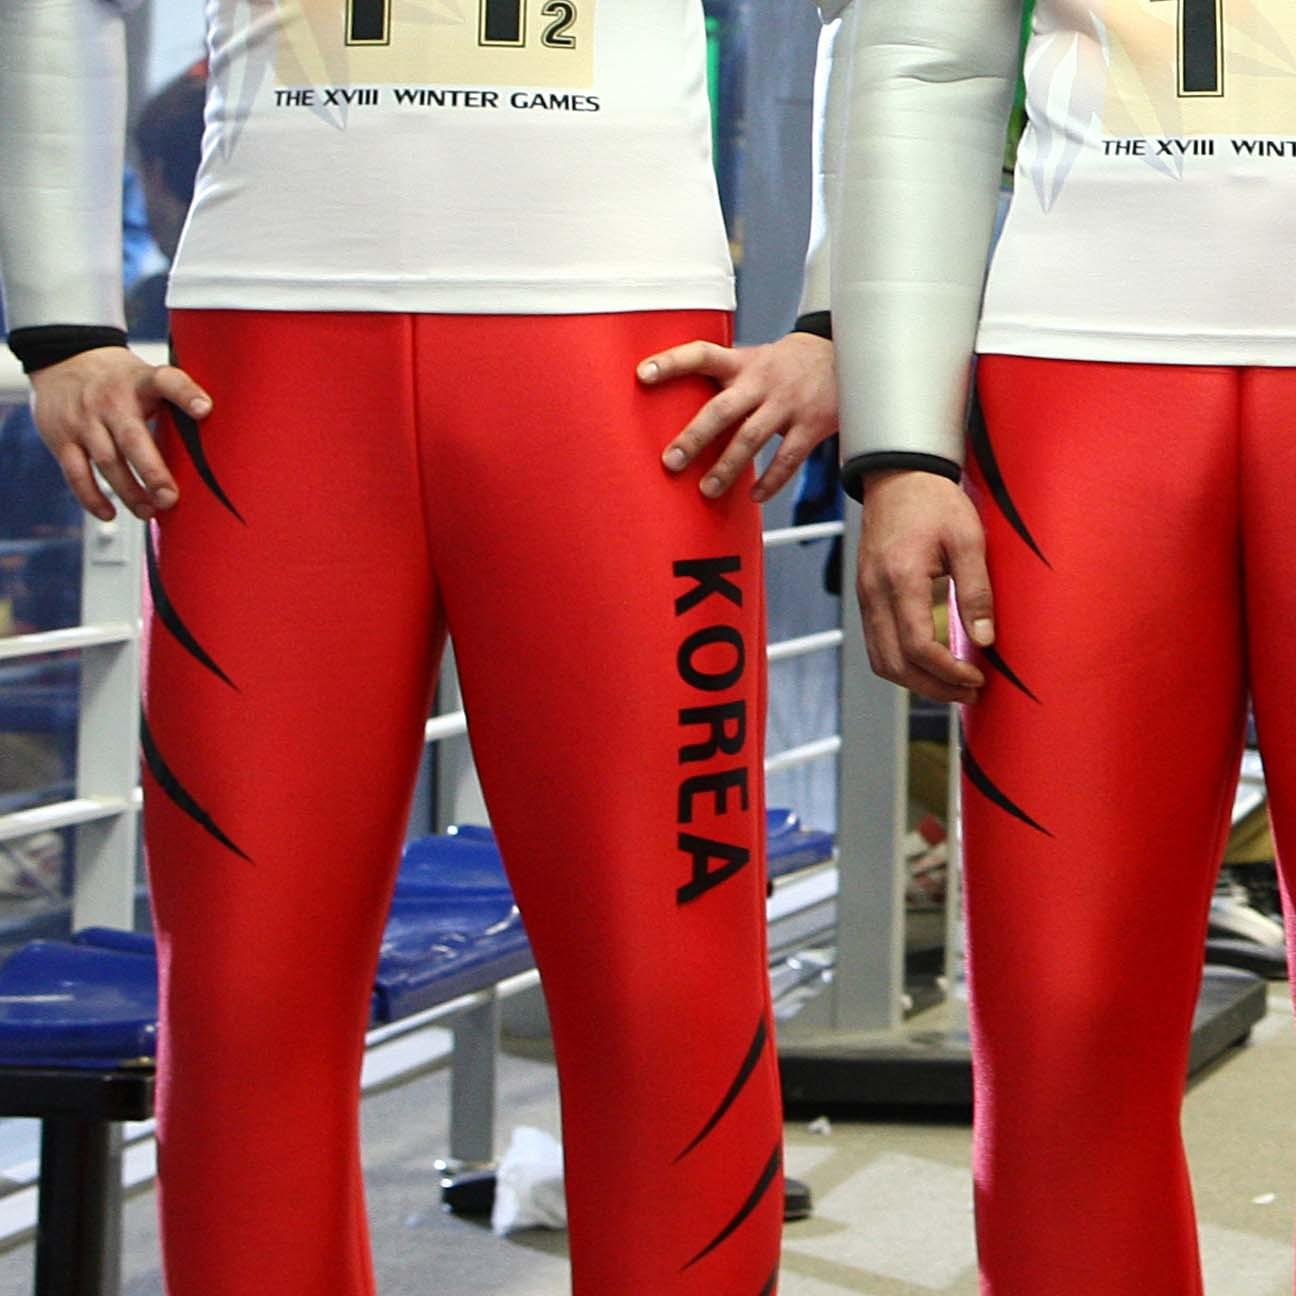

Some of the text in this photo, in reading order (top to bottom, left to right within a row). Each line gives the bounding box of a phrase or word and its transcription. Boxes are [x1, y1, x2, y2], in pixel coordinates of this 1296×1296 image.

[540, 0, 577, 50] 2
[274, 88, 600, 113] THE XVIII WINTER GAMES
[1101, 137, 1148, 157] THE
[1155, 138, 1215, 158] XVIII
[672, 555, 751, 905] KOREA
